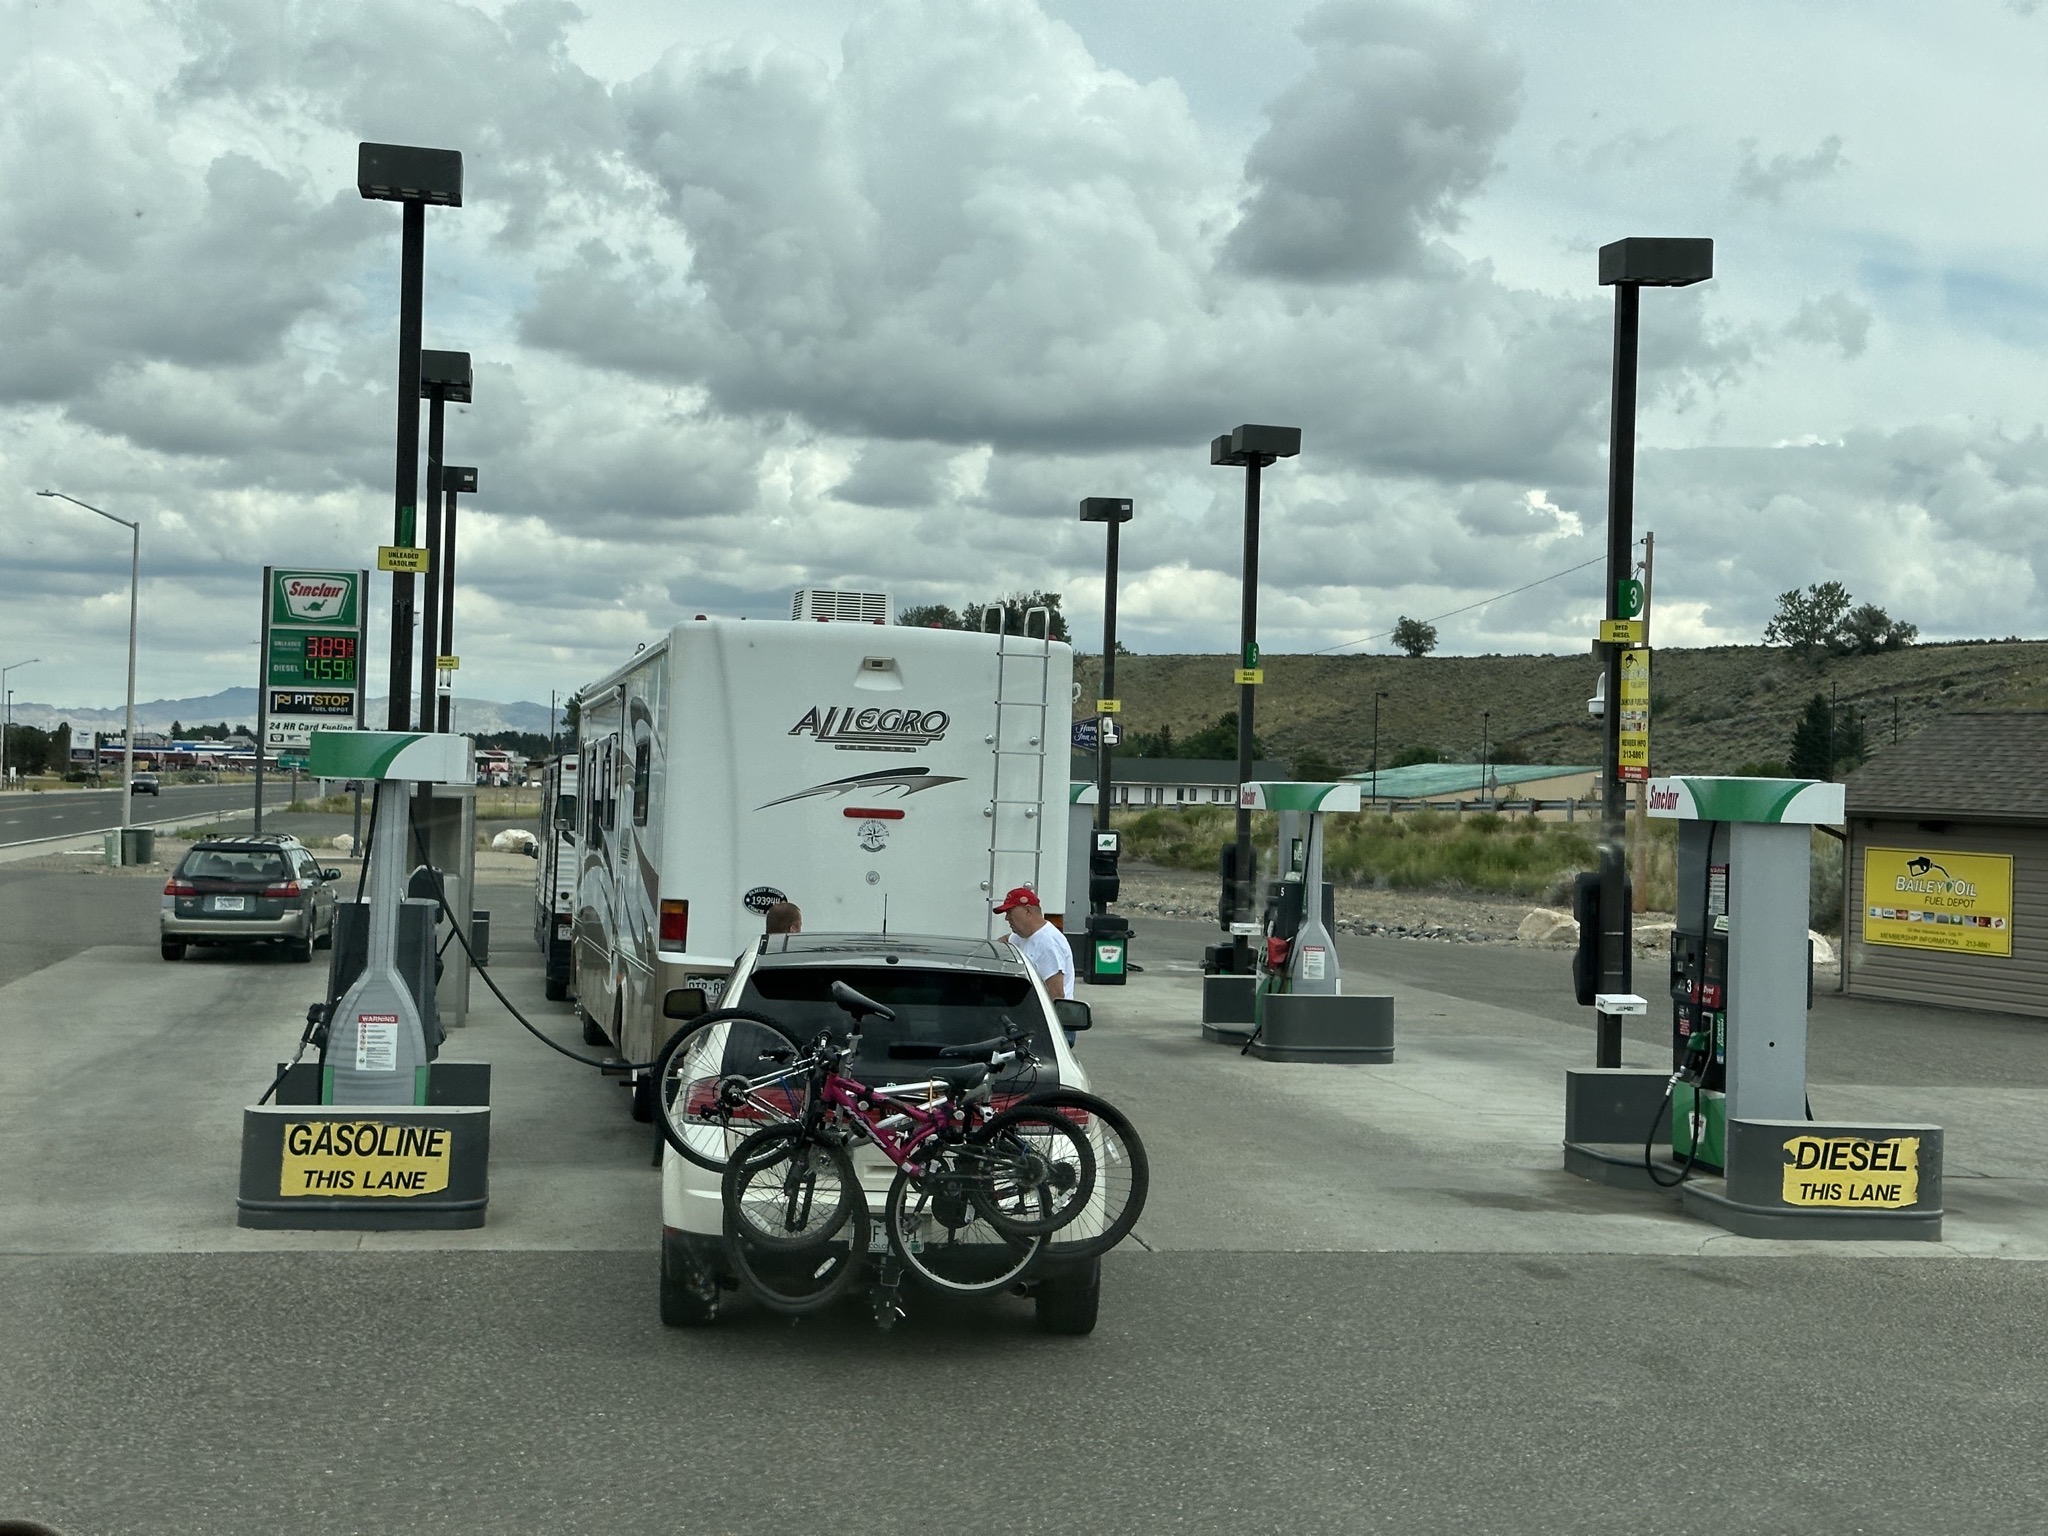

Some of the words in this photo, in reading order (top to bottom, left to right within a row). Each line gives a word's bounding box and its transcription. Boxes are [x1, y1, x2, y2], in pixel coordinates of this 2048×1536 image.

[388, 552, 419, 560] UNLEADED
[289, 582, 343, 598] Sinclair
[1630, 587, 1638, 608] 3
[308, 637, 346, 658] 3.89
[1253, 648, 1257, 662] 5
[274, 664, 299, 672] DIESEL
[305, 660, 345, 679] 4.59
[295, 694, 349, 706] PITSTOP
[269, 723, 281, 731] 24
[283, 723, 296, 731] HR
[298, 723, 319, 731] Card
[788, 705, 950, 744] ALLEGRO
[1649, 785, 1679, 810] Sinclair
[1895, 875, 1945, 893] BAILEY
[1953, 879, 1977, 896] OIL
[1924, 896, 1945, 906] FUEL
[1947, 897, 1975, 908] DEPOT
[1880, 932, 1918, 942] MEMBERSHIP
[1919, 936, 1959, 946] INFORMATION
[1687, 979, 1692, 993] 3
[1703, 985, 1714, 995] Dyed
[288, 1124, 446, 1157] GASOLINE
[1796, 1141, 1907, 1171] DIESEL
[303, 1170, 356, 1189] THIS
[363, 1171, 428, 1189] LANE
[1800, 1183, 1842, 1200] THIS
[1848, 1184, 1902, 1201] LANE
